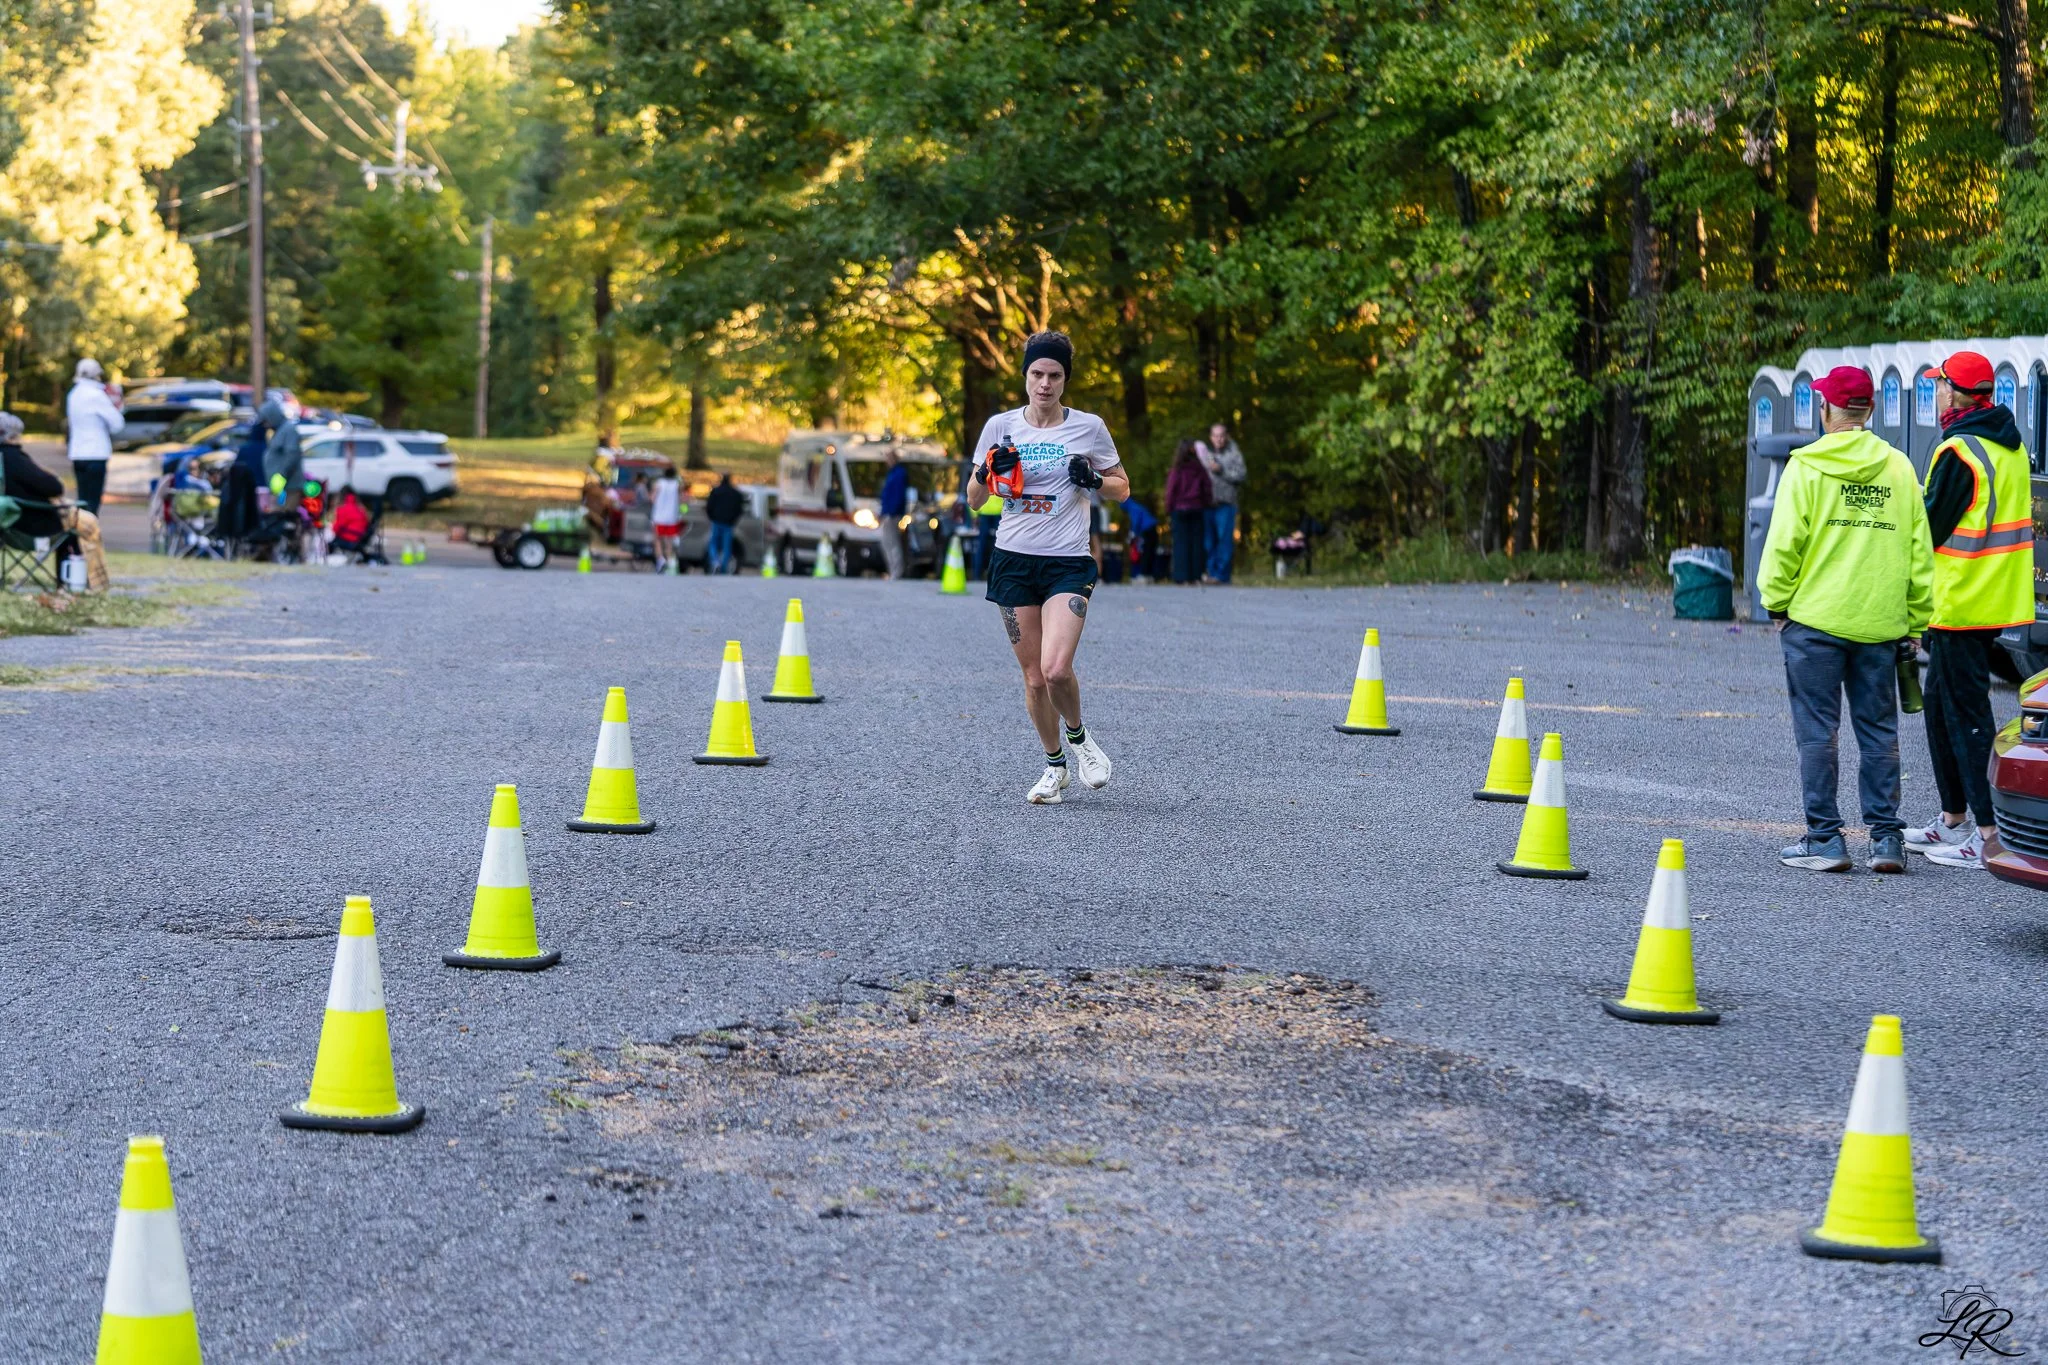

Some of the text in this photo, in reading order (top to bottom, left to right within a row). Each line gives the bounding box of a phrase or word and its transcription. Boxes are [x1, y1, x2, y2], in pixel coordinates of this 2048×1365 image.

[1018, 447, 1065, 456] HICAGO
[1841, 484, 1892, 498] MEMPHIS
[1022, 500, 1053, 514] 229
[1845, 496, 1885, 506] RUNNERS
[1826, 519, 1897, 531] FINISH LINE CREW
[1925, 830, 1941, 843] N
[1959, 846, 1977, 858] N
